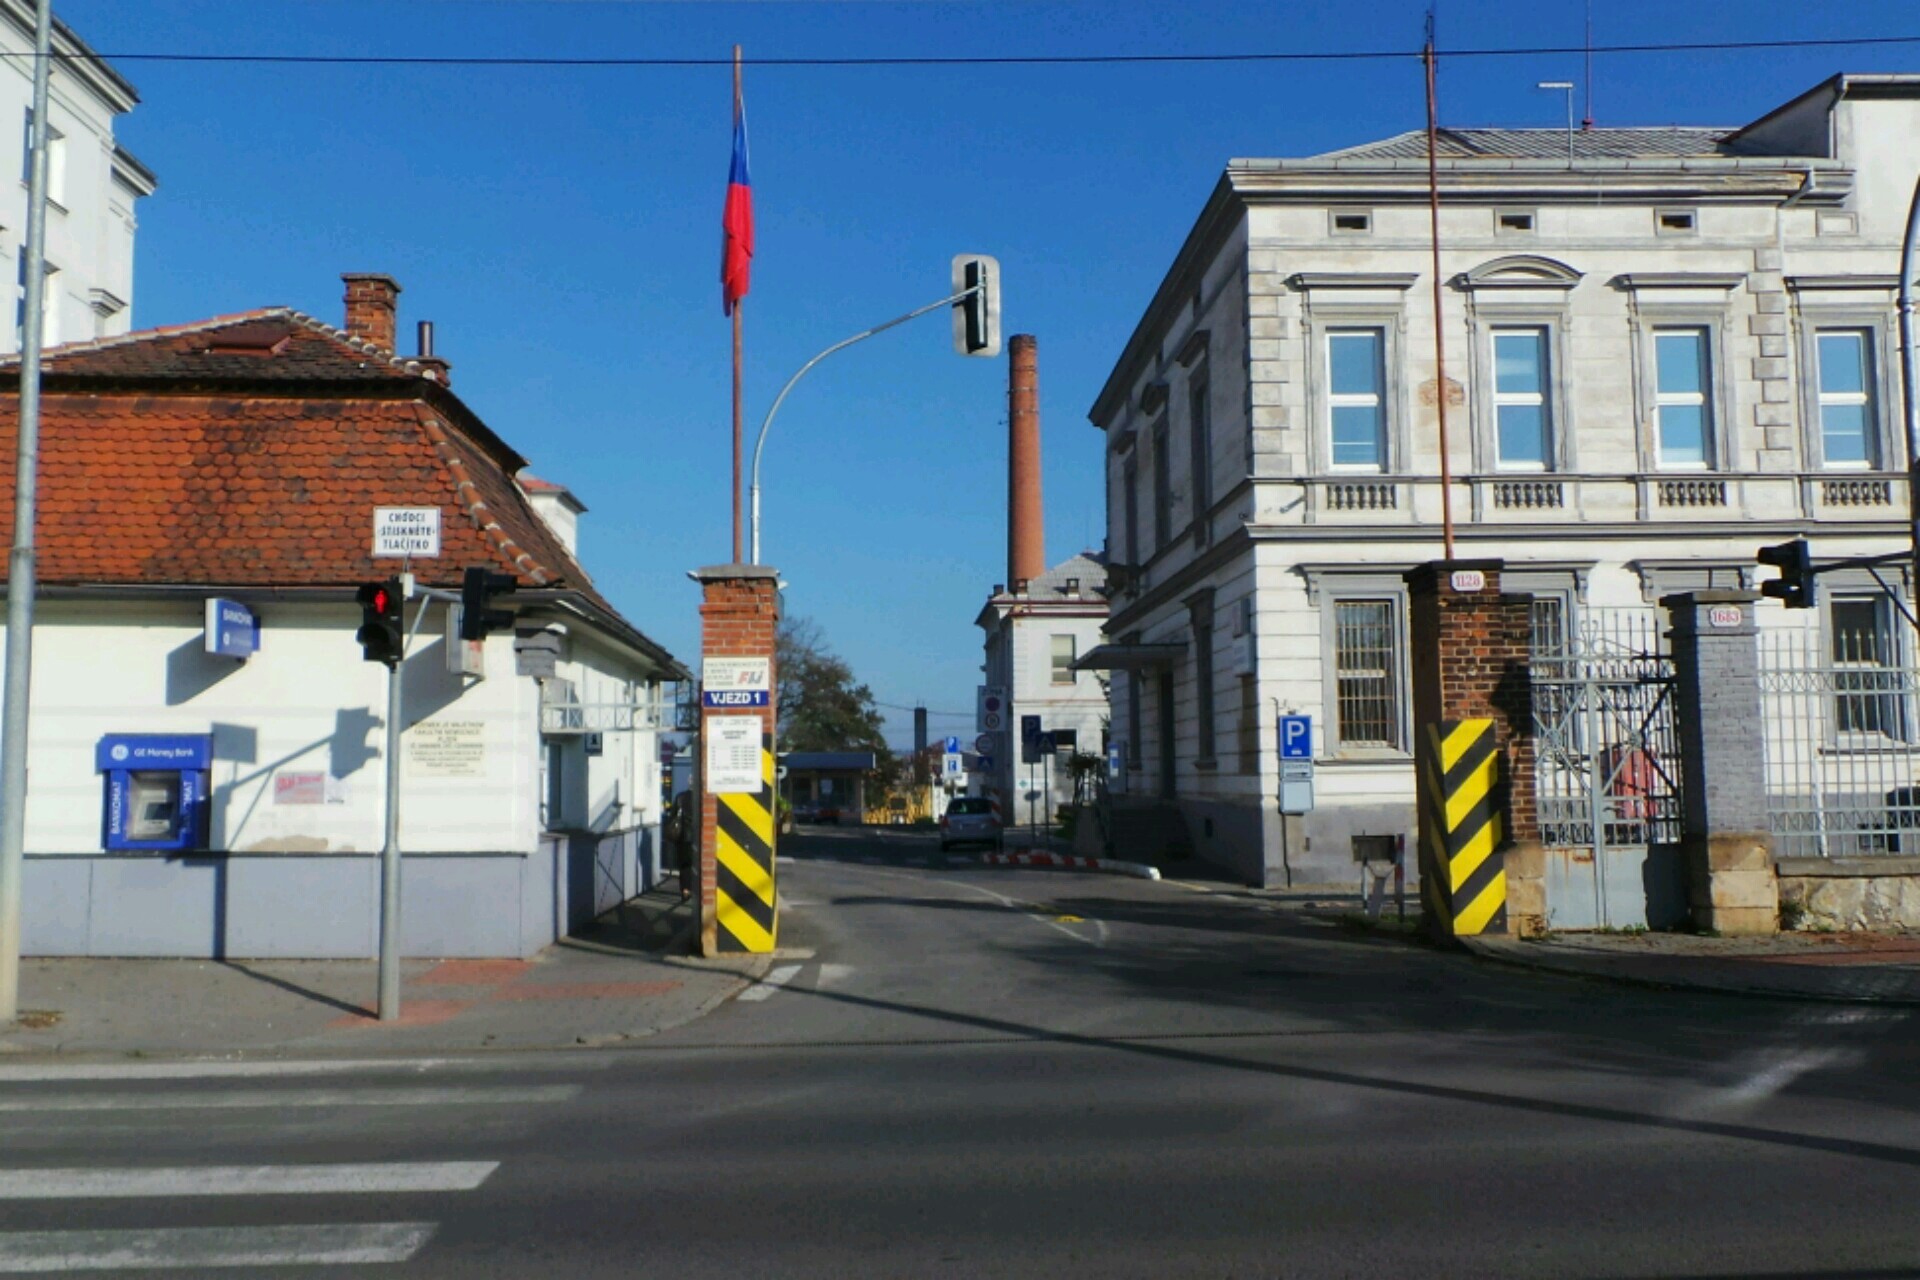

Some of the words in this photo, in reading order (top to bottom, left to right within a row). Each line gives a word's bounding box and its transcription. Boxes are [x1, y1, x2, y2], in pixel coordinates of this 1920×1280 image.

[1455, 574, 1480, 587] 1128
[711, 692, 751, 704] VJEZD
[754, 692, 760, 704] 1
[1287, 720, 1305, 746] P
[134, 748, 145, 757] GE
[147, 748, 173, 758] Money
[175, 748, 194, 757] Bank
[112, 782, 121, 834] BANKOMAT
